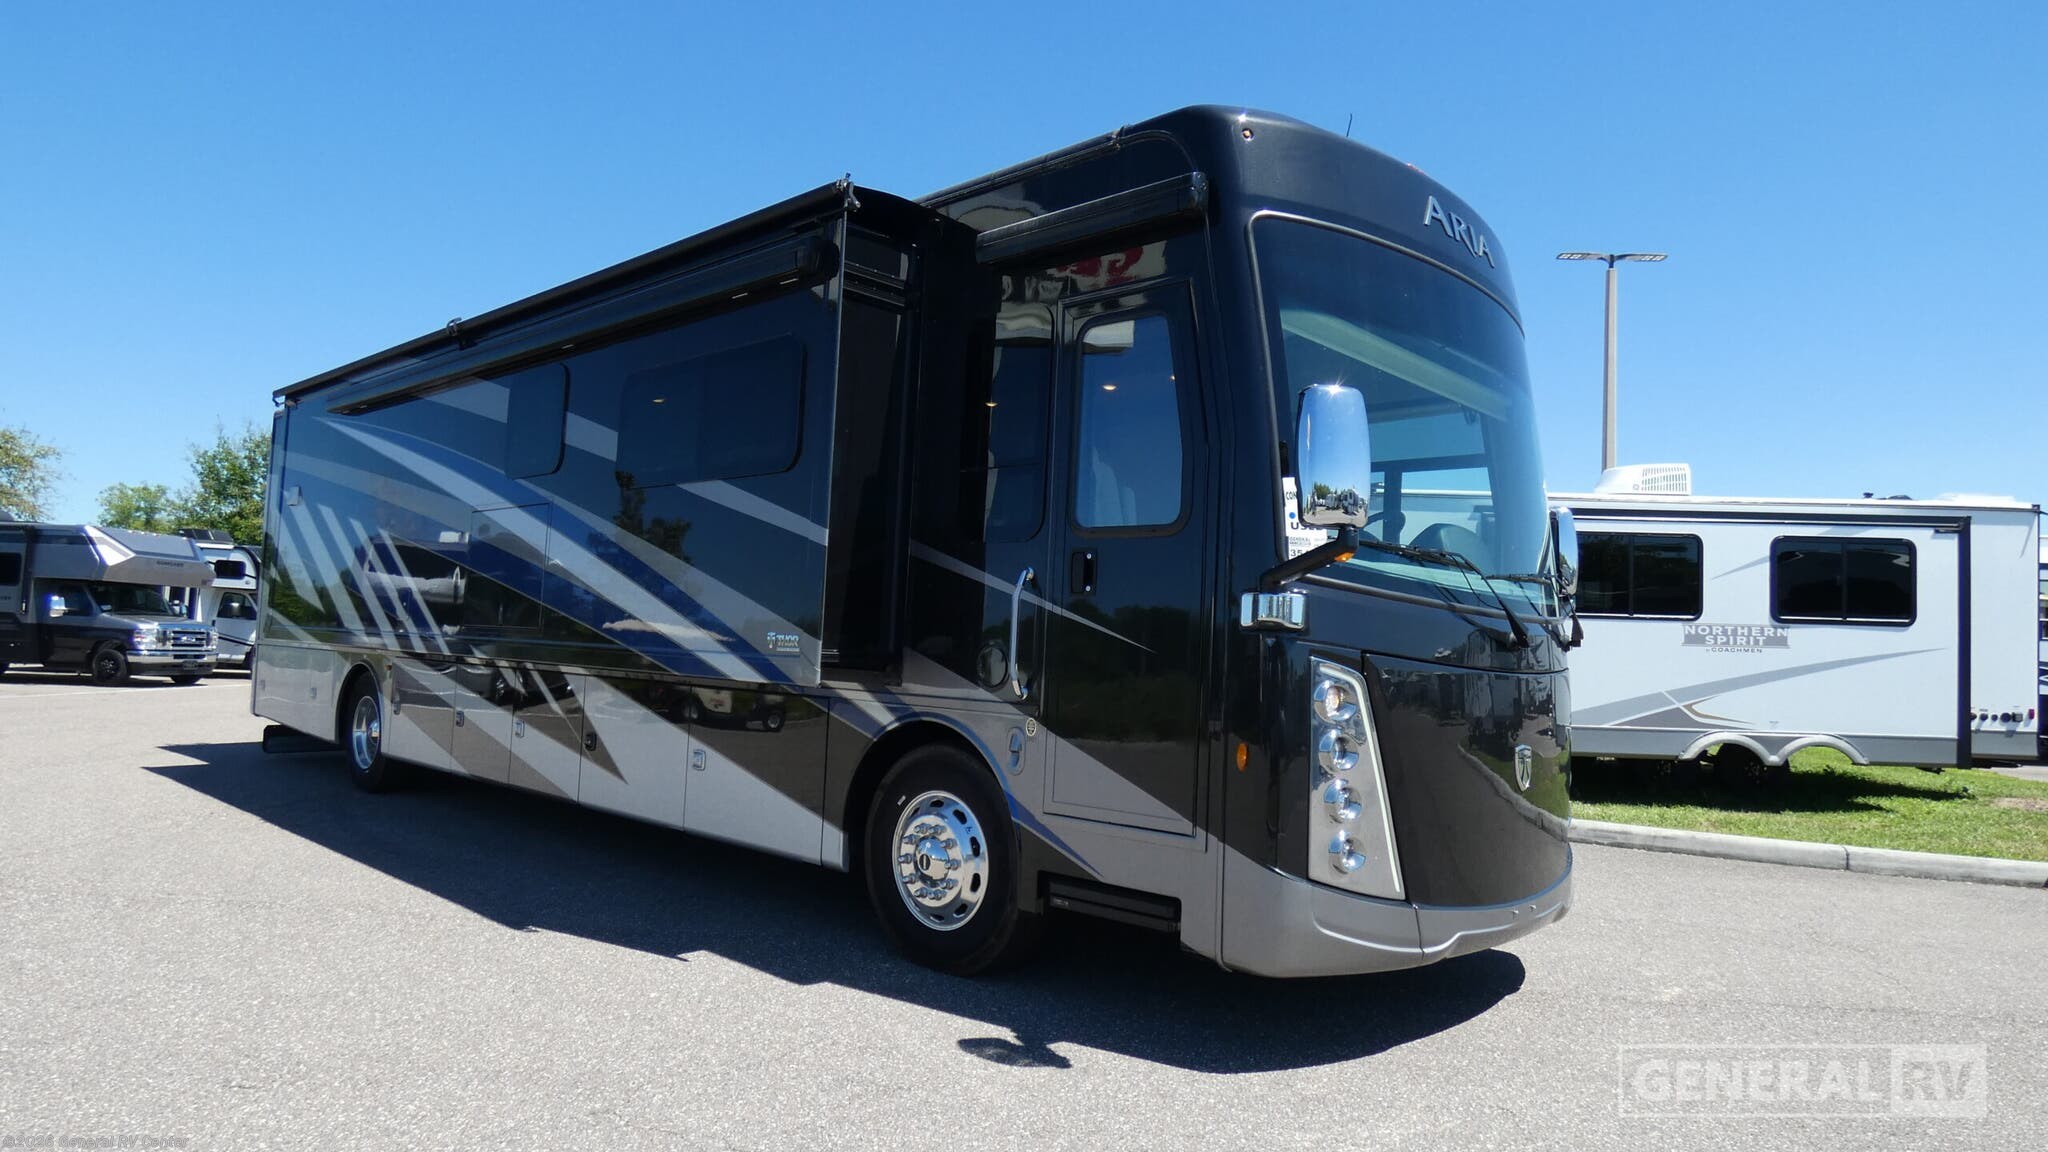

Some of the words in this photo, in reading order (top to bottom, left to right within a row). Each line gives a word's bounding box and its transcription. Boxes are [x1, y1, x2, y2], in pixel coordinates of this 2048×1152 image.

[1423, 195, 1495, 268] ARIA
[1684, 625, 1789, 637] NORTHERN
[1705, 635, 1767, 646] SPIRIT
